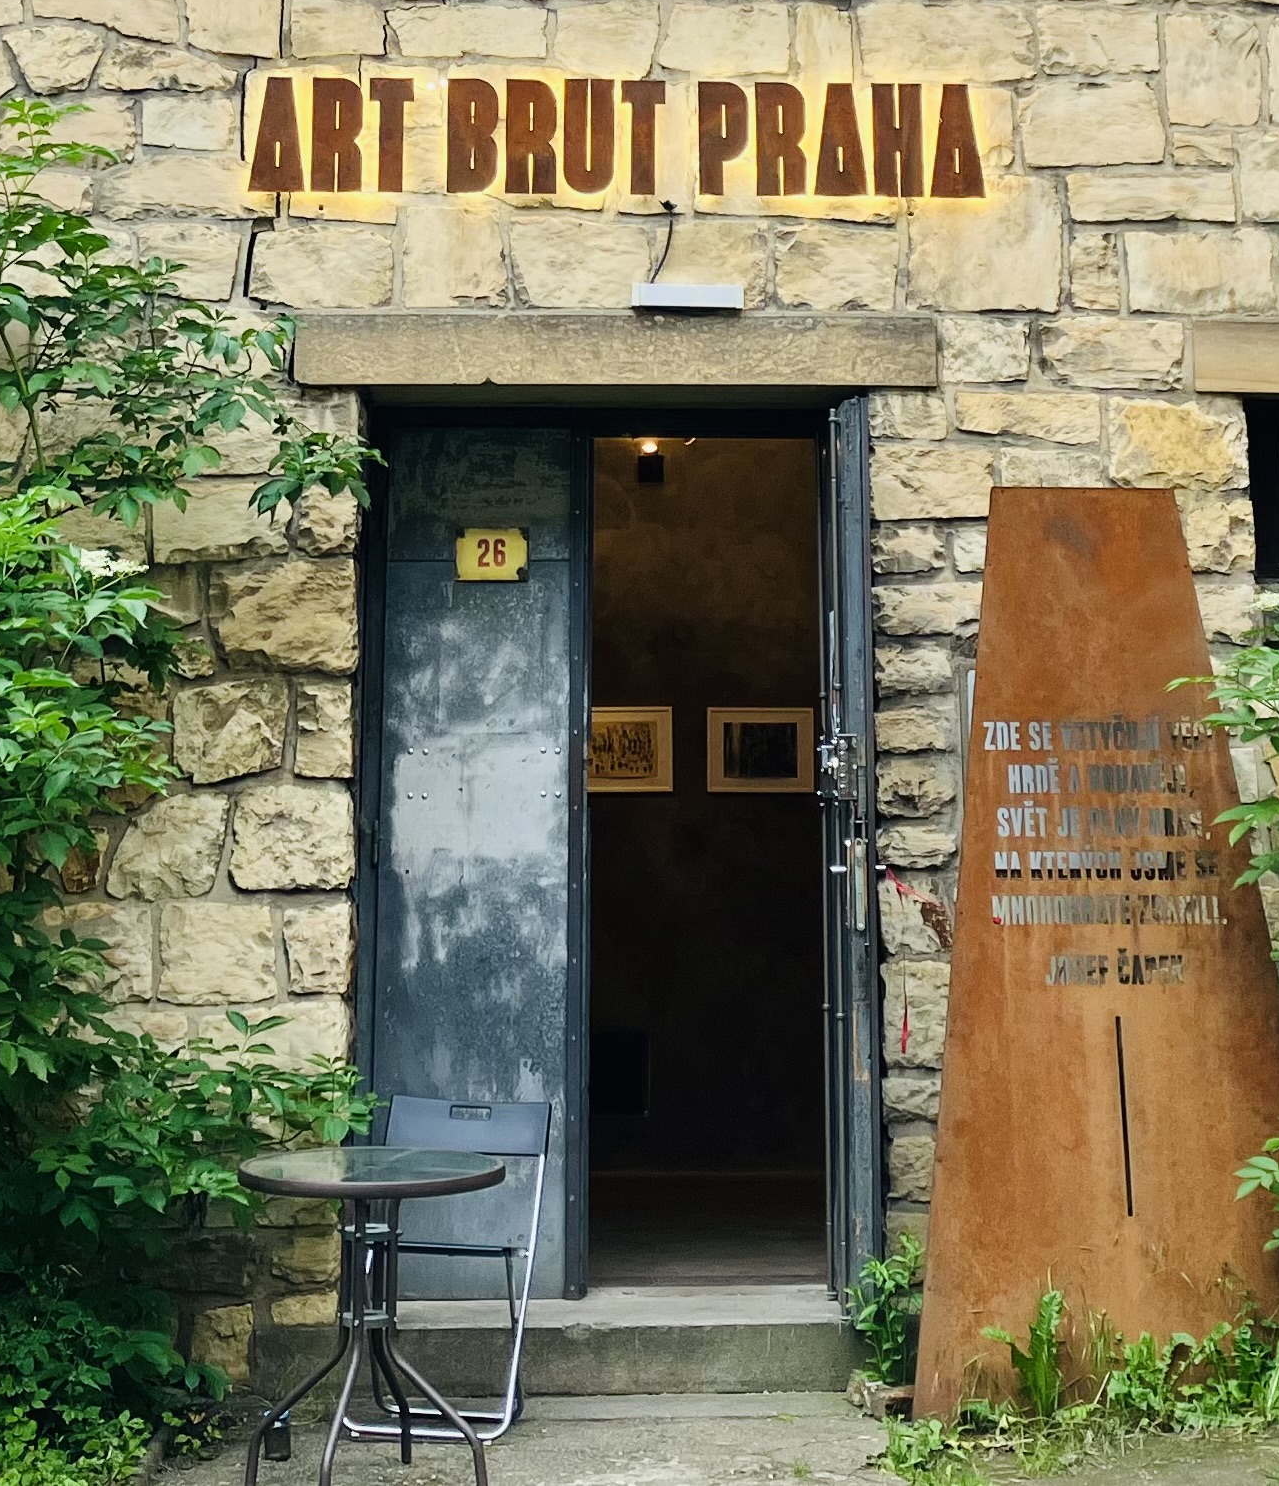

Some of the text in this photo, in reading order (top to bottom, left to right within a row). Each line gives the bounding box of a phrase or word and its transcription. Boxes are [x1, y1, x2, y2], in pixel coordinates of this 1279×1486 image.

[248, 76, 987, 199] ART BRUT PRAHA
[477, 537, 507, 568] 26
[982, 720, 1022, 752] ZDE
[1028, 720, 1054, 752] SE
[1007, 756, 1061, 795] HRDĚ
[1067, 764, 1082, 795] A
[996, 800, 1049, 838] SVĚT
[1057, 806, 1081, 838] JE
[994, 843, 1219, 882] NA KTERÝCH JSME SE
[1044, 948, 1186, 988] JOSEF ČAPEK
